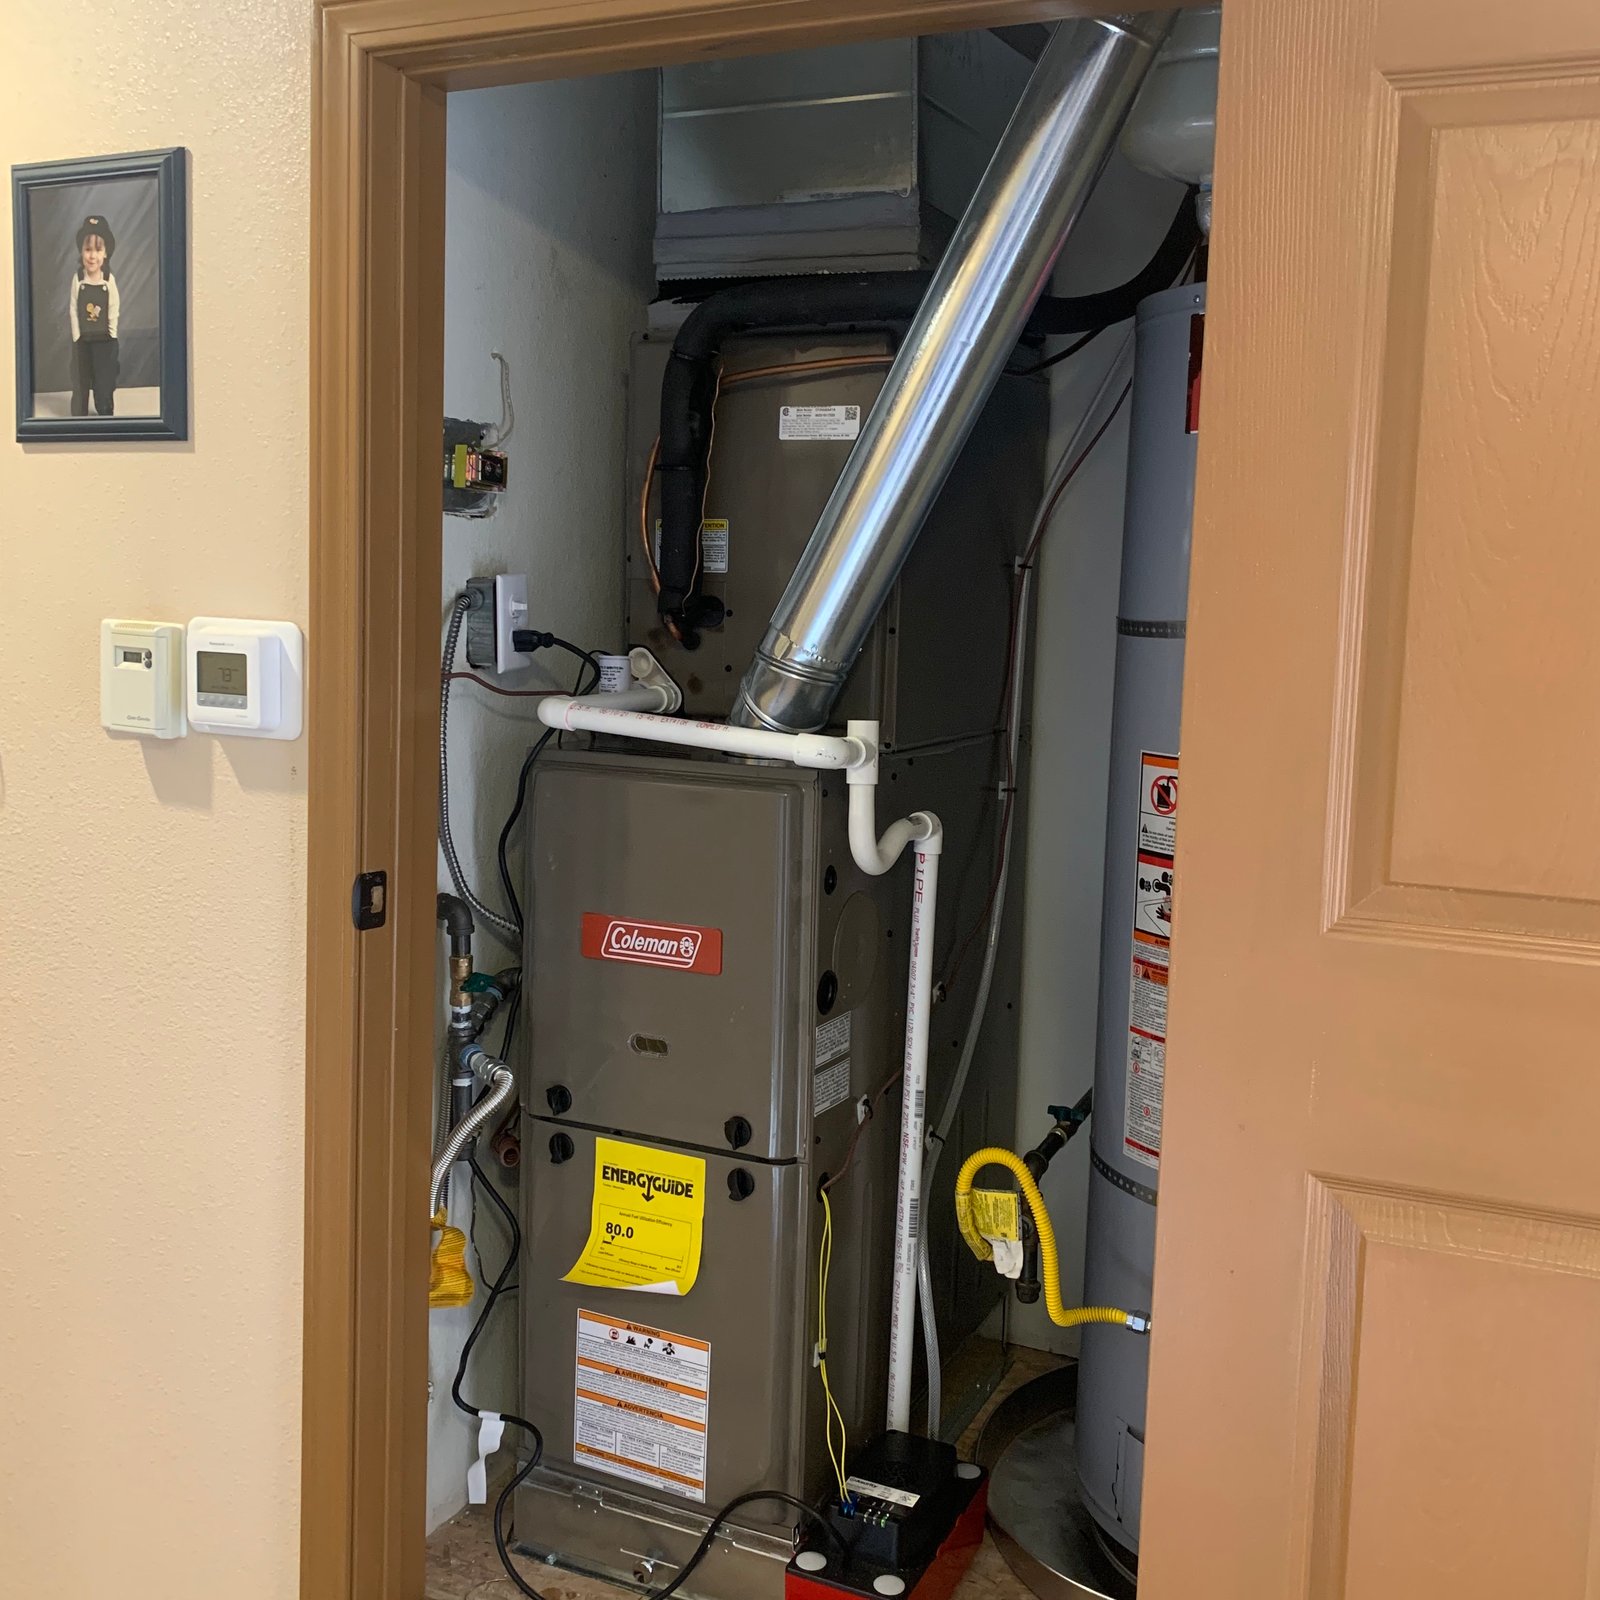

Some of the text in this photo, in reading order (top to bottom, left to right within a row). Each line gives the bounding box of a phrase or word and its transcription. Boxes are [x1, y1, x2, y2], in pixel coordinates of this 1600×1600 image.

[914, 852, 926, 904] PIPE
[610, 926, 678, 955] Coleman
[606, 1222, 634, 1238] 80.0
[632, 1326, 660, 1338] WARNING
[622, 1370, 668, 1388] AVERTISSEMENT
[624, 1404, 664, 1418] ADVERTENCIA
